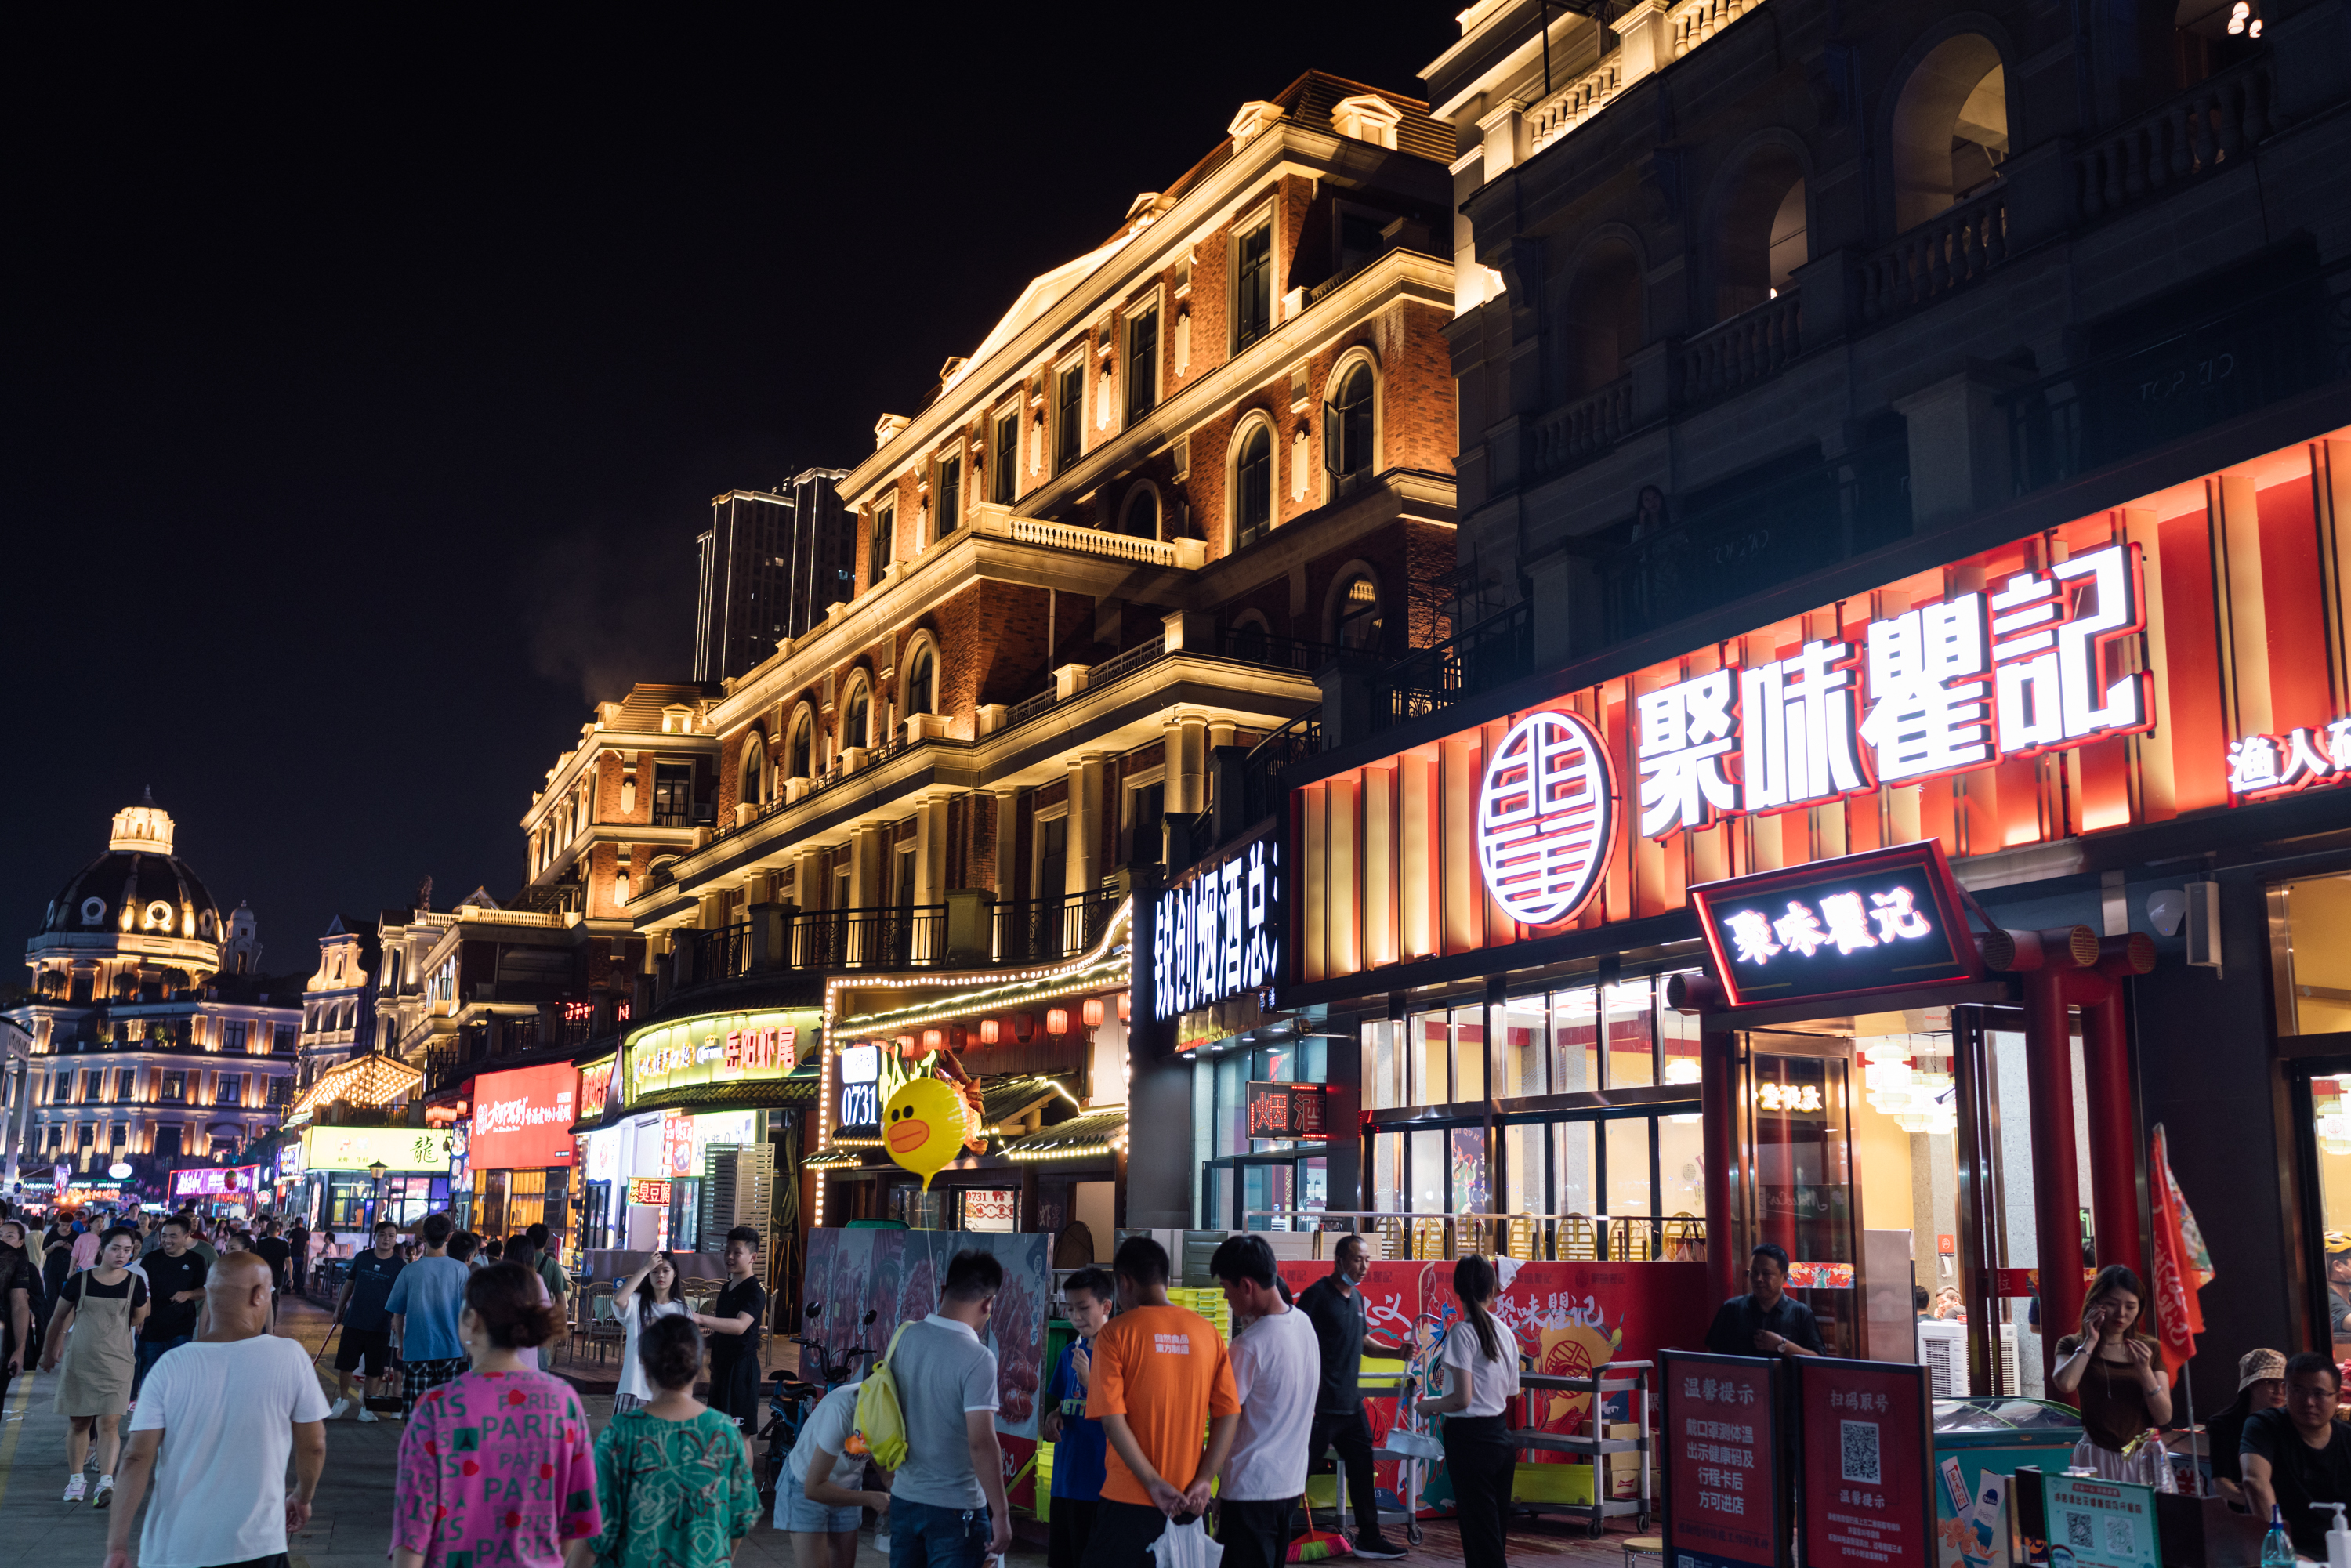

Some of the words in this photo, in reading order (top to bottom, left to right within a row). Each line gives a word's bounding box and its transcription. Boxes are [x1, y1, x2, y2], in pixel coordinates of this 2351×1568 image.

[1724, 886, 1931, 965] 聚味瞿记
[725, 1026, 798, 1074] 岳阳虾尾
[842, 1084, 878, 1126] 0731
[1255, 1092, 1325, 1131] 烟酒
[409, 1135, 439, 1164] 龍
[639, 1181, 670, 1204] 臭豆腐
[966, 1192, 987, 1201] 0731
[1154, 1333, 1190, 1344] 自然食品
[1684, 1377, 1755, 1405] 温馨提示
[1831, 1389, 1889, 1413] 扫码取号
[482, 1414, 565, 1440] PARIS
[1686, 1418, 1755, 1444] 戴口罩测体温
[1686, 1441, 1755, 1469] 出示健康码及
[1697, 1466, 1744, 1491] 行程卡后
[1698, 1490, 1744, 1515] 方可进店
[1839, 1489, 1886, 1508] 温馨提示
